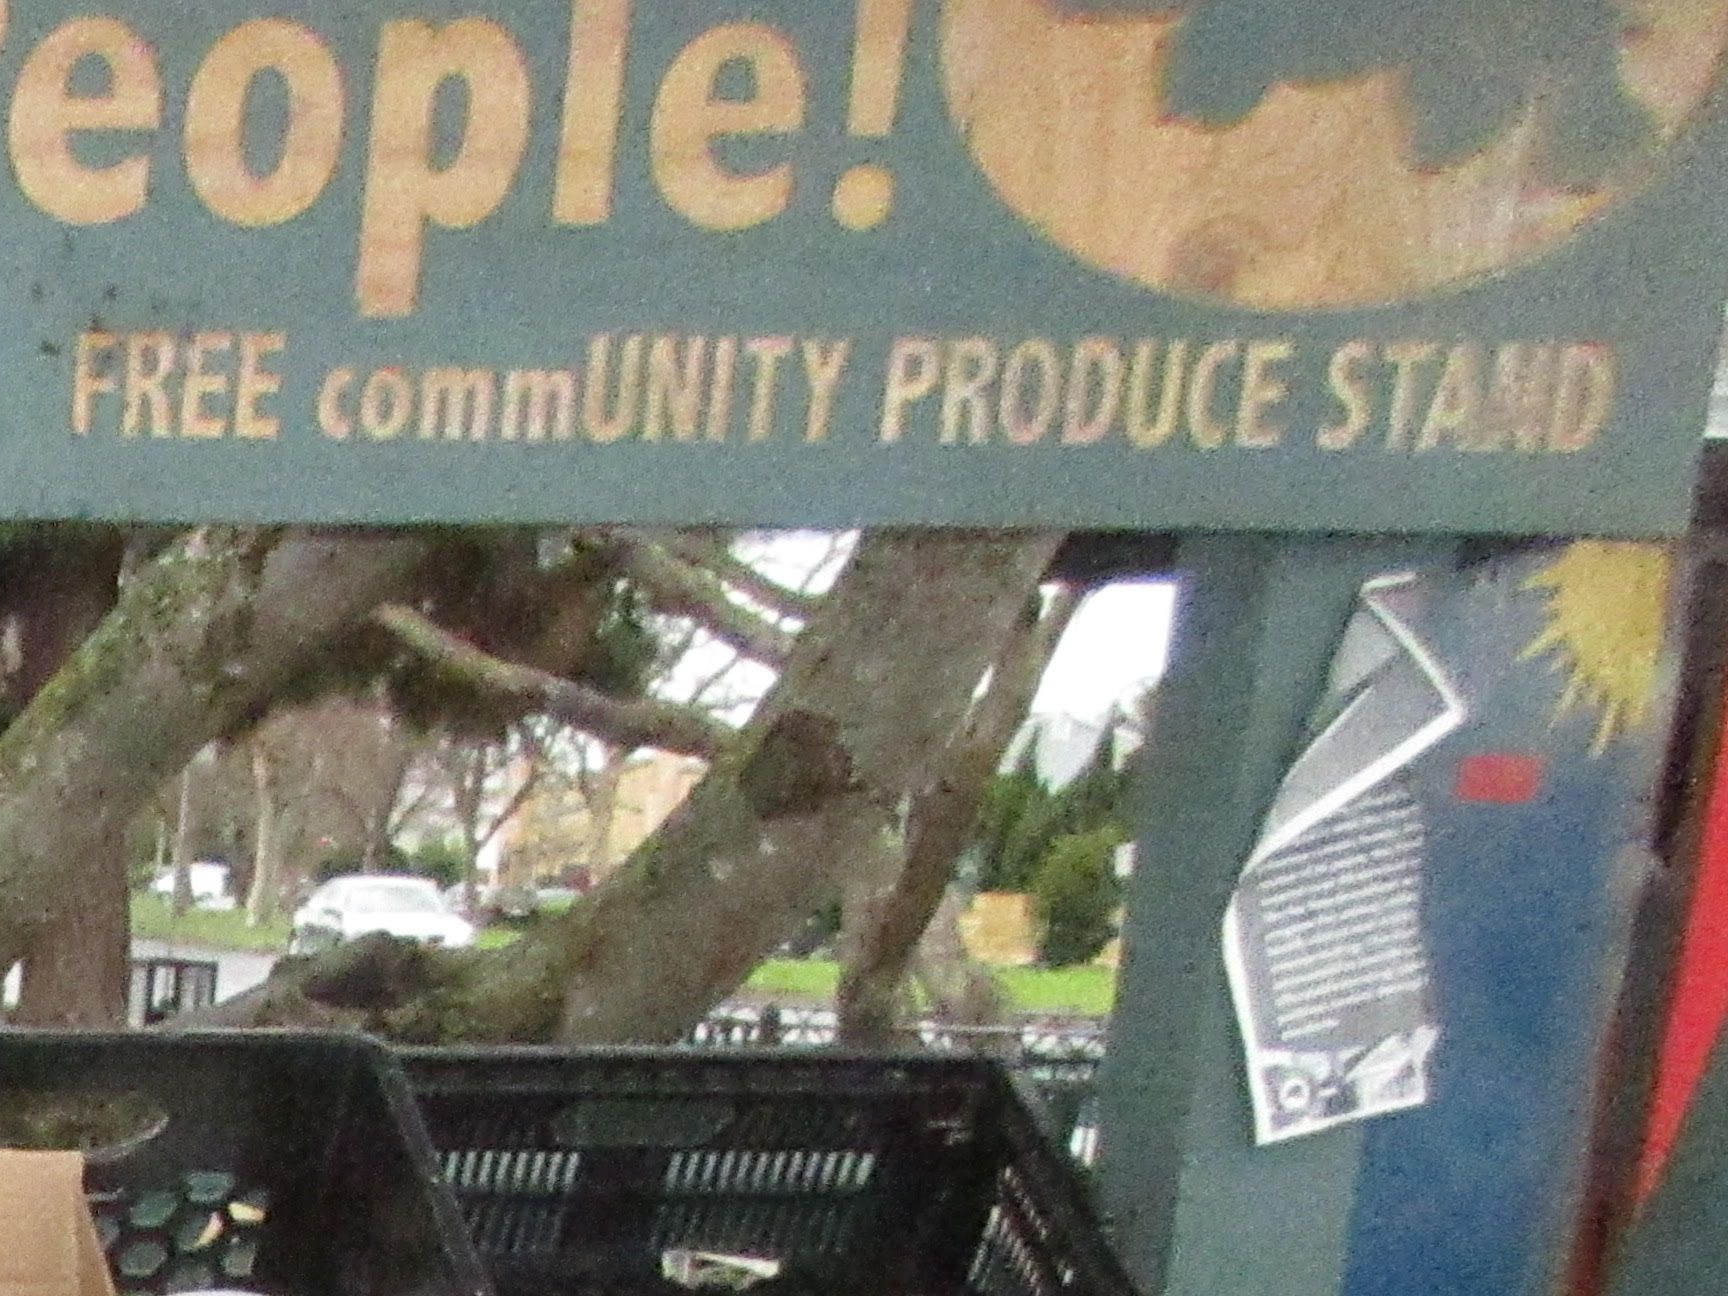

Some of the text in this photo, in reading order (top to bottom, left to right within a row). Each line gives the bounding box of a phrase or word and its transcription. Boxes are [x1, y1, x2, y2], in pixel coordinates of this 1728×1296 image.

[70, 329, 1619, 454] FREE commUNITY PRODUCE STAND
